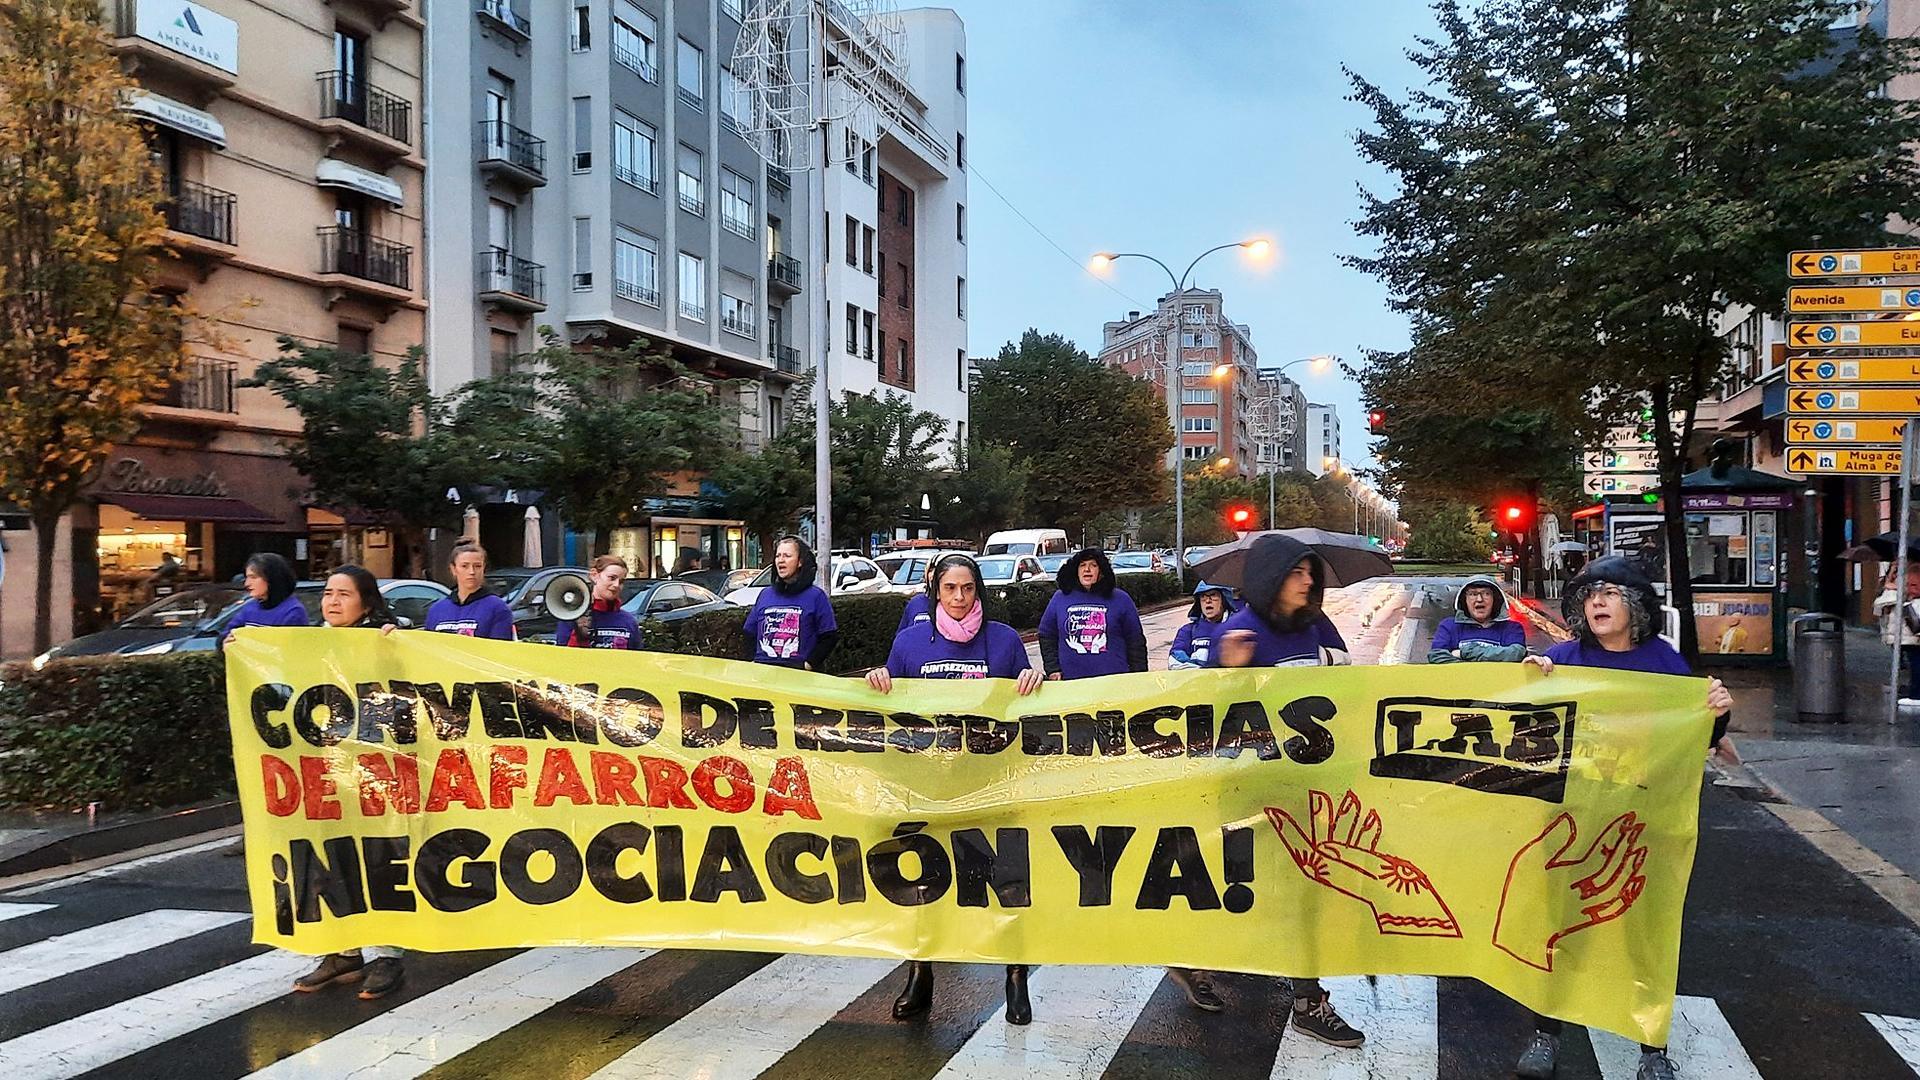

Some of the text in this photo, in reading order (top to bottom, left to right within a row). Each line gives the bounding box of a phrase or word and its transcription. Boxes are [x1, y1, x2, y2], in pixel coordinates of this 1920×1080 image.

[157, 30, 219, 61] AMENABAR
[1893, 252, 1918, 260] Gran
[1892, 262, 1908, 271] La
[1793, 295, 1845, 305] Avenida
[1901, 328, 1920, 339] Eu
[1849, 451, 1902, 463] Muga de
[1844, 461, 1901, 471] Alma Pa
[251, 679, 1338, 765] CONVENIO DE RESIDENCIAS
[1387, 710, 1562, 767] LAB
[260, 745, 823, 821] DE NAFARROA
[271, 821, 1255, 937] ¡NEGOCIACIÓN YA!
